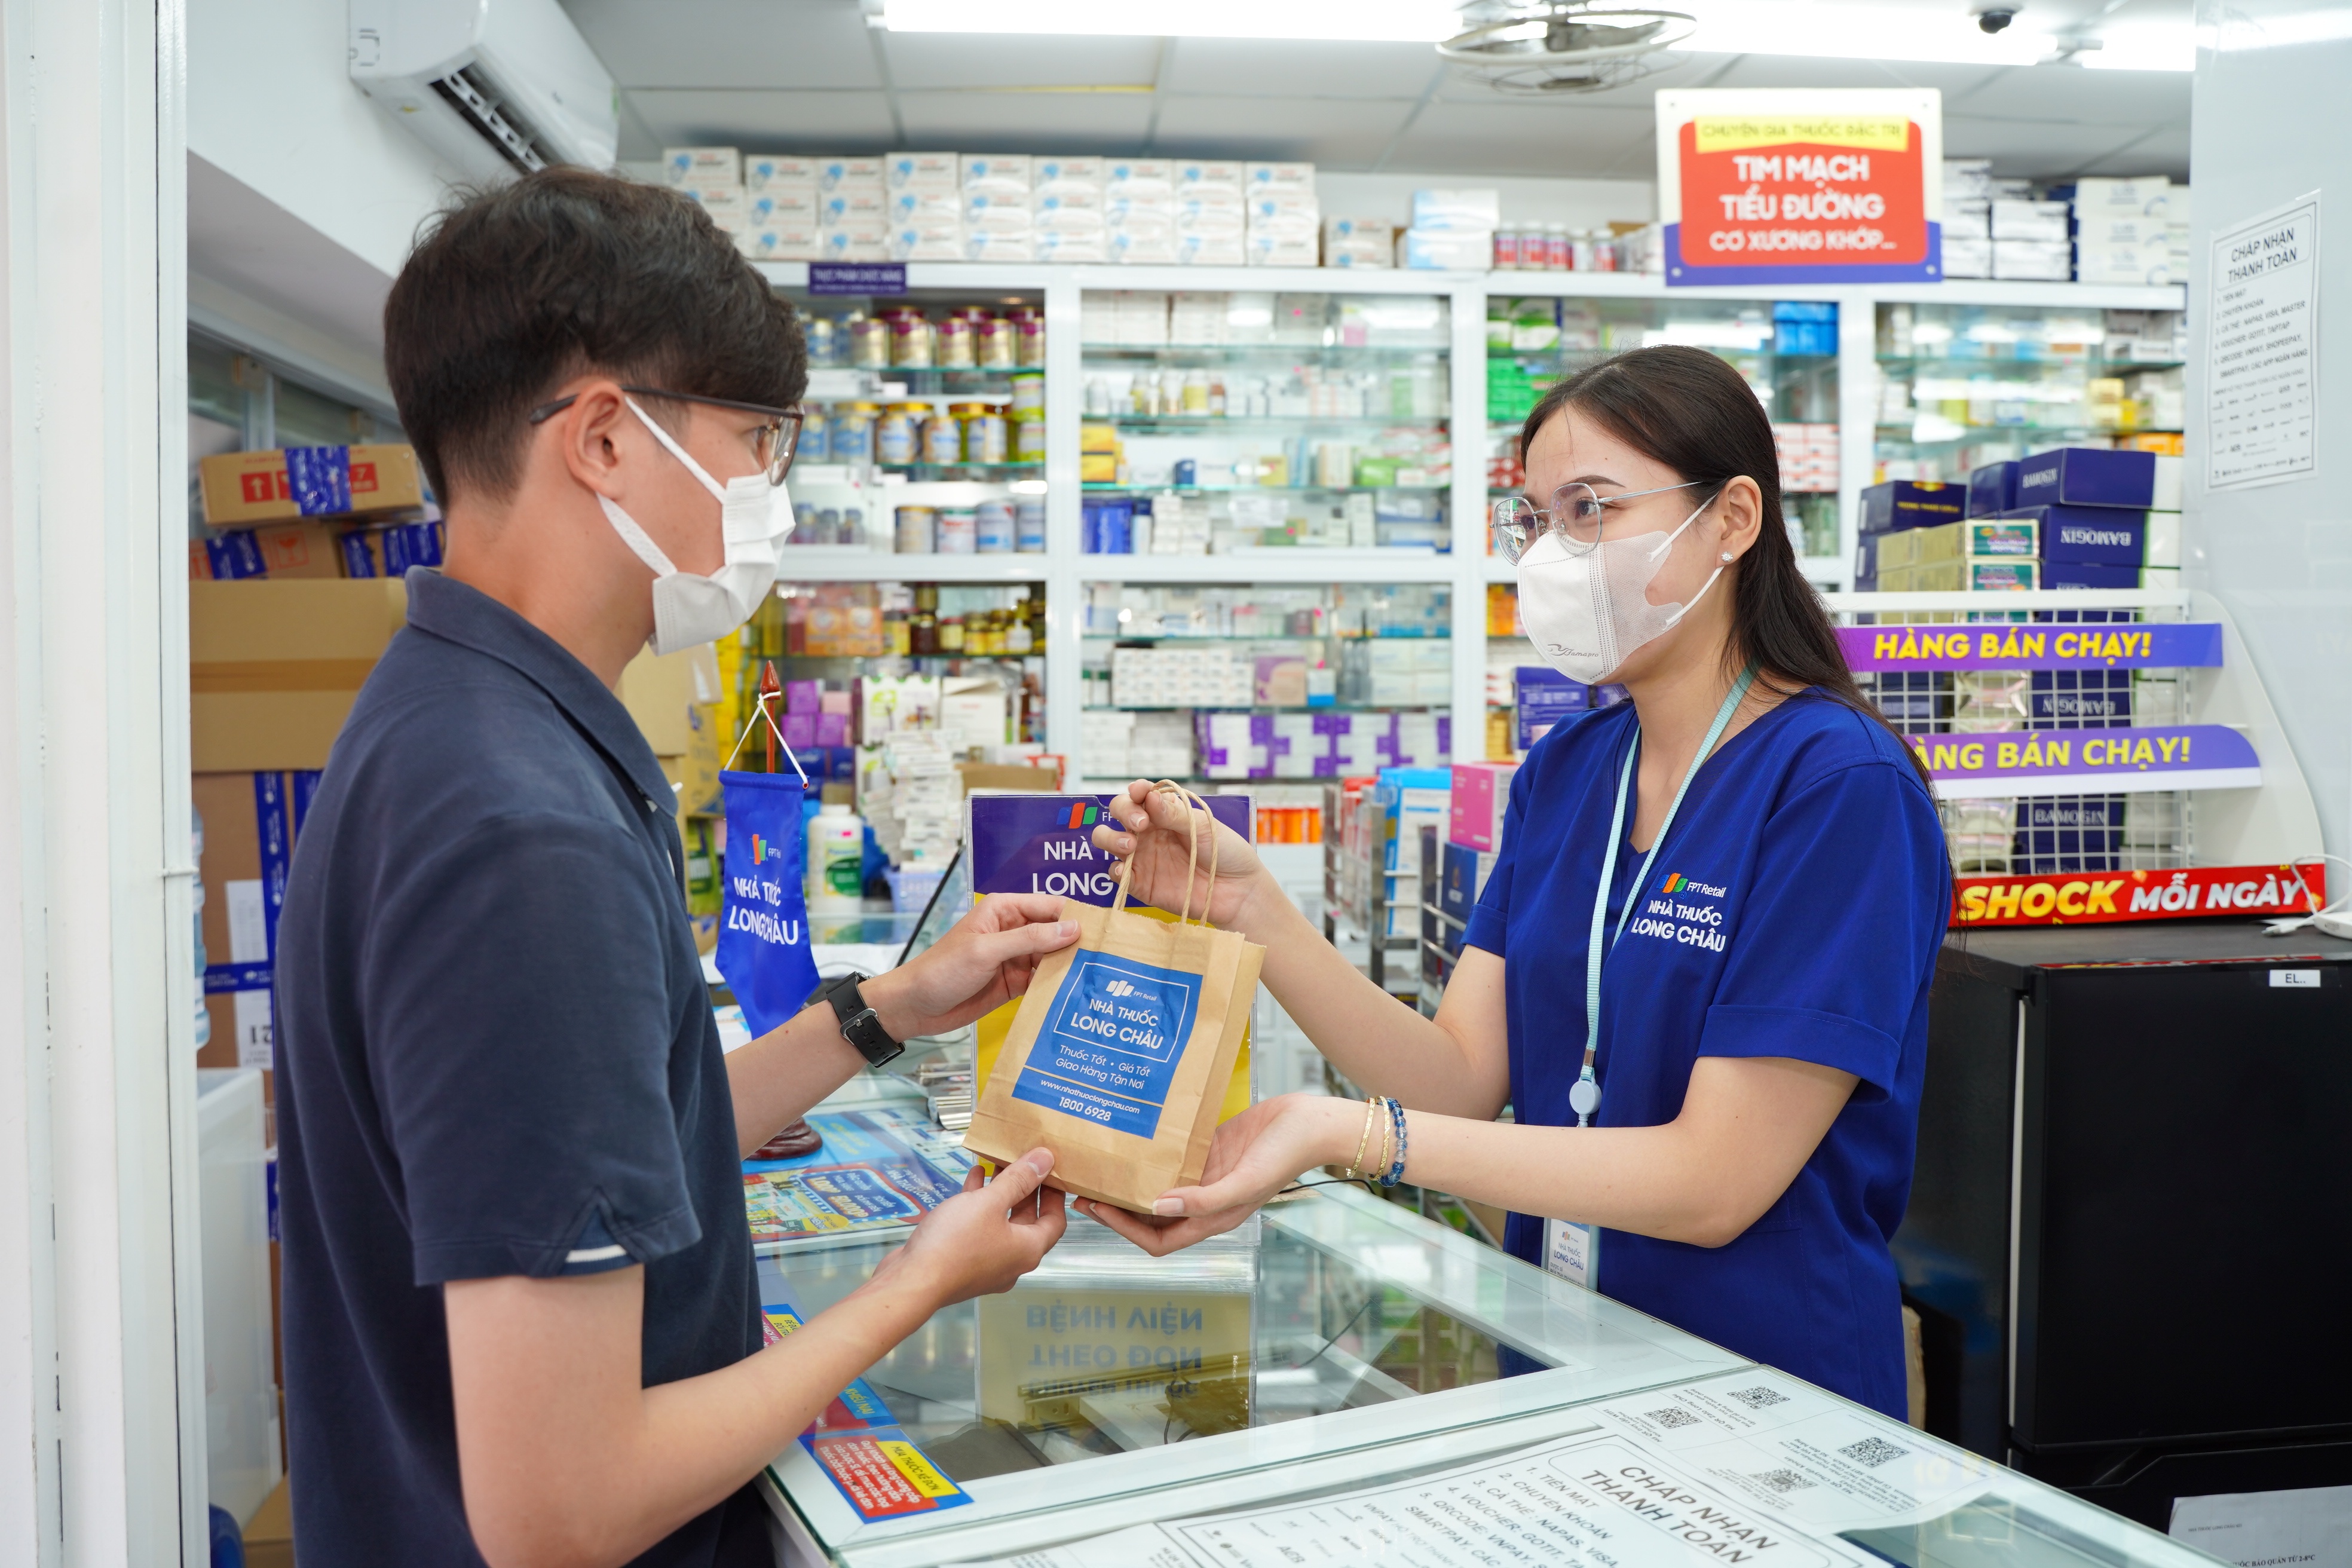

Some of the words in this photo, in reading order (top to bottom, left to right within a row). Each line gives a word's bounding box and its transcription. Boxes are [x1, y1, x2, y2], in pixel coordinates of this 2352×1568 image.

[1732, 155, 1782, 182] TIM
[1785, 154, 1869, 189] MẠCH
[1719, 183, 1778, 221] TIỂU
[1781, 186, 1886, 220] ĐƯỜNG
[1709, 229, 1745, 252] CƠ
[1748, 229, 1823, 251] XƯƠNG
[1826, 225, 1897, 250] KHỚP...
[2231, 238, 2261, 263] CHẤP
[2263, 226, 2295, 250] NHẬN
[2228, 259, 2264, 284] THANH
[2267, 244, 2298, 269] TOÁN
[2060, 528, 2132, 547] BAMOGIN
[1873, 627, 1971, 659] HÀNG
[1979, 627, 2047, 659] BÁN
[2054, 631, 2152, 666] CHẠY!
[1996, 733, 2071, 768] BÁN
[2082, 736, 2192, 771] CHẠY!
[1043, 835, 1093, 860] NHÀ
[734, 874, 761, 901] NHÀ
[1032, 872, 1114, 896] LONG
[1687, 881, 1702, 893] FPT
[1702, 885, 1727, 898] Retail
[1958, 880, 2124, 921] SHOCK
[2129, 872, 2201, 913] MỖI
[2206, 874, 2305, 909] NGÀY
[1647, 899, 1673, 917] NHÀ
[1676, 904, 1723, 926] THUỐC
[1631, 917, 1675, 940] LONG
[1677, 926, 1726, 953] CHÂU
[1133, 990, 1144, 999] FPT
[1143, 993, 1157, 1002] Retail
[1089, 998, 1114, 1015] NHÀ
[1116, 1006, 1159, 1027] THUỐC
[1070, 1012, 1117, 1037] LONG
[1119, 1026, 1163, 1050] CHÂU
[1055, 1058, 1079, 1072] Giao
[1079, 1064, 1108, 1083] Hàng
[1109, 1073, 1128, 1089] Tận
[1128, 1078, 1145, 1090] Nơi
[1059, 1045, 1089, 1061] Thuốc
[1091, 1052, 1107, 1067] Tốt
[1118, 1059, 1135, 1074] Giá
[1135, 1064, 1151, 1077] Tốt
[1040, 1079, 1140, 1114] www.nhathuoclongchau.com
[1058, 1096, 1085, 1113] 1800
[1084, 1104, 1111, 1122] 6928
[1554, 1250, 1569, 1263] LONG
[1569, 1257, 1584, 1270] CHÂU
[1558, 1242, 1567, 1251] NHÀ
[1567, 1247, 1581, 1258] THUỐC
[844, 1388, 871, 1404] KHIẾU
[1671, 1394, 1688, 1402] Châu
[1688, 1401, 1702, 1410] Long
[1703, 1410, 1716, 1419] Zalo
[866, 1463, 881, 1475] theo
[867, 1448, 886, 1464] khách
[895, 1478, 912, 1493] cung
[891, 1445, 904, 1458] MUA
[901, 1456, 923, 1474] THUỐC
[923, 1478, 941, 1491] ĐƠN
[1803, 1466, 1832, 1483] Chuyển
[1472, 1479, 1486, 1487] 3.
[1362, 1502, 1398, 1523] VNPAY
[1419, 1492, 1432, 1500] 5.
[1432, 1500, 1490, 1535] QRCODE:
[1460, 1494, 1523, 1533] VOUCHER:
[1512, 1481, 1567, 1512] CHUYỂN
[1561, 1511, 1613, 1539] KHOẢN
[1581, 1469, 1674, 1521] THANH
[1670, 1520, 1753, 1563] TOÁN
[1619, 1466, 1696, 1505] CHẤP
[1696, 1506, 1780, 1549] NHẬN
[1277, 1545, 1306, 1563] ACB
[2252, 1558, 2266, 1567] BẢO
[2267, 1556, 2286, 1566] QUẢN
[2288, 1555, 2298, 1563] TỪ
